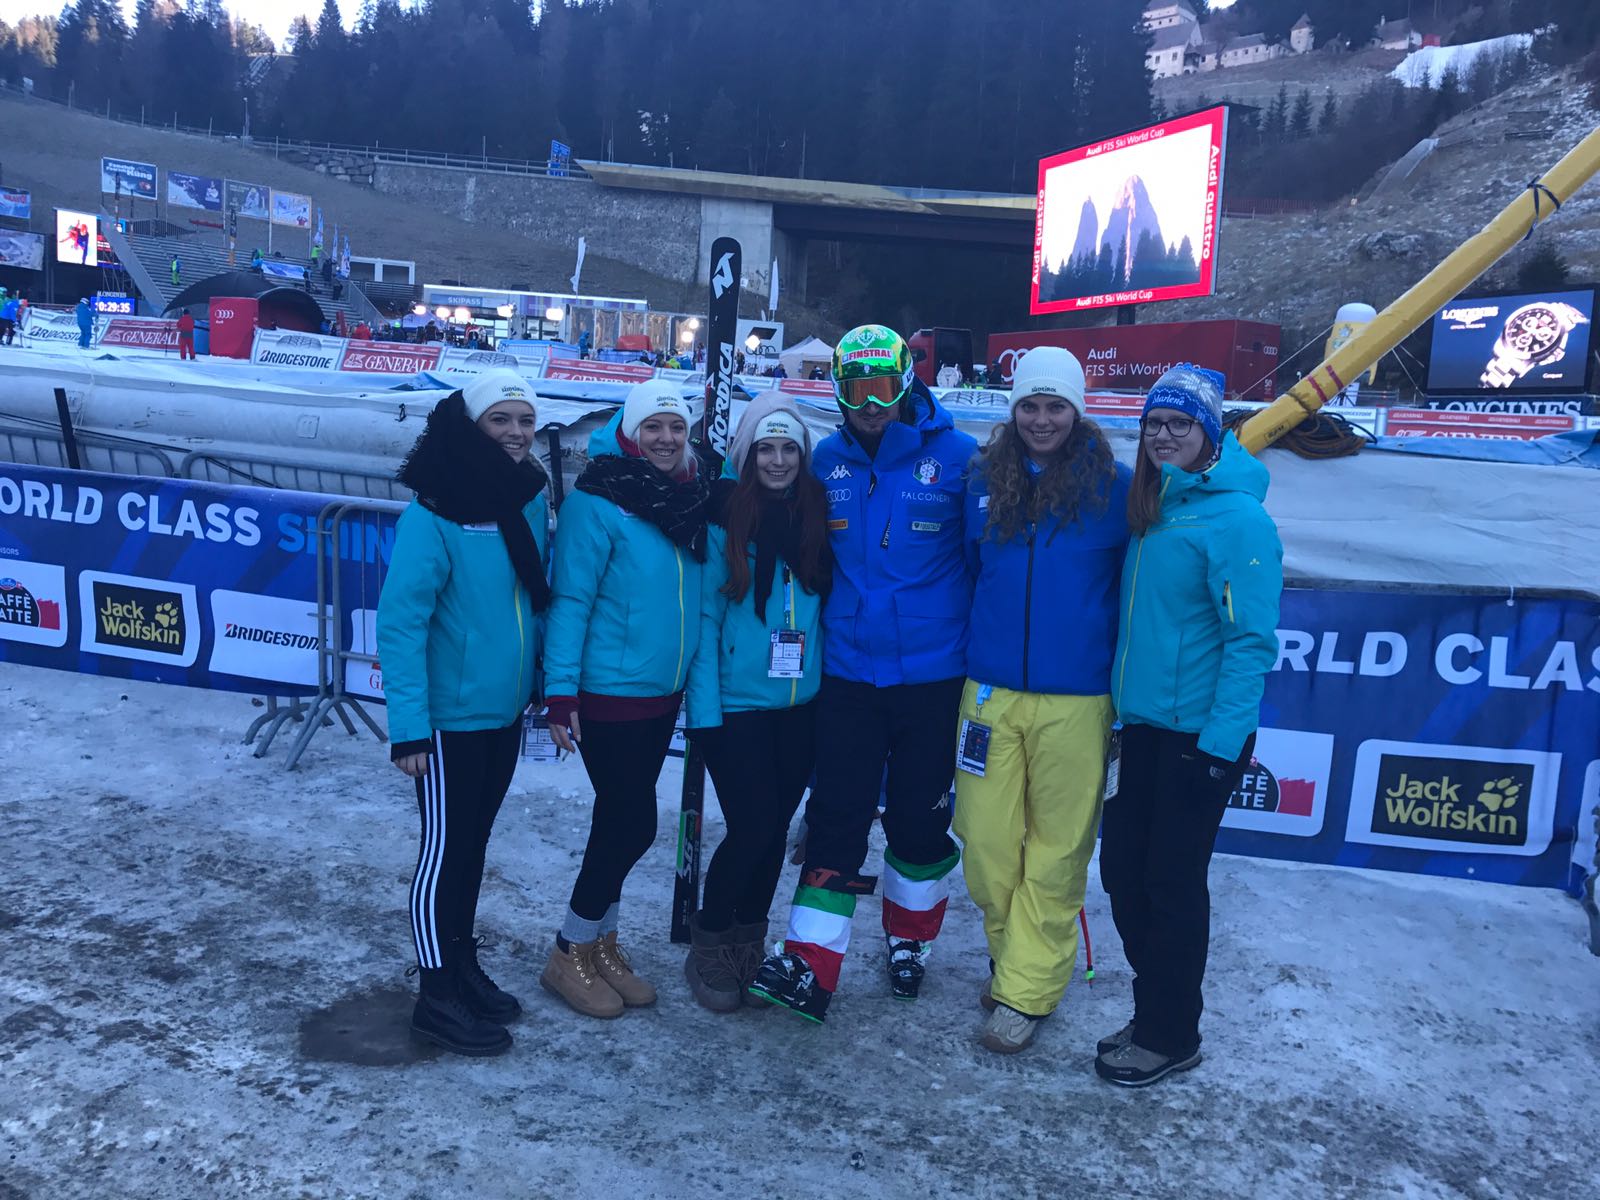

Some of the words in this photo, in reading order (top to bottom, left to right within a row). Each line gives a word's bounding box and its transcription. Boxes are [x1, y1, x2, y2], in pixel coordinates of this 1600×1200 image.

[1085, 144, 1102, 156] Audi
[1103, 141, 1115, 152] FIS
[1116, 138, 1126, 149] Ski
[1127, 131, 1149, 145] World
[1150, 128, 1165, 140] Cup
[1208, 145, 1220, 187] Audi
[1035, 189, 1045, 247] quattro
[1202, 191, 1215, 259] quattro
[1031, 250, 1040, 285] Audi
[447, 296, 481, 306] SKIPASS
[1076, 297, 1092, 307] Audi
[1092, 295, 1104, 305] FIS
[1105, 293, 1115, 303] Ski
[1116, 291, 1137, 302] World
[1138, 290, 1153, 300] Cup
[122, 331, 181, 346] GENERALI
[259, 350, 334, 369] BRIDGESTONE
[848, 349, 892, 360] FINSTRAL
[1087, 347, 1118, 361] Audi
[1085, 364, 1105, 377] FIS
[1108, 363, 1127, 376] Ski
[1131, 362, 1171, 376] World
[708, 342, 734, 458] NORDICA
[117, 491, 261, 547] CLASS
[100, 596, 145, 620] Jack
[101, 616, 180, 646] Wolfskin
[224, 623, 328, 651] BRIDGESTON
[1386, 773, 1462, 803] Jack
[1385, 798, 1518, 836] Wolfskin
